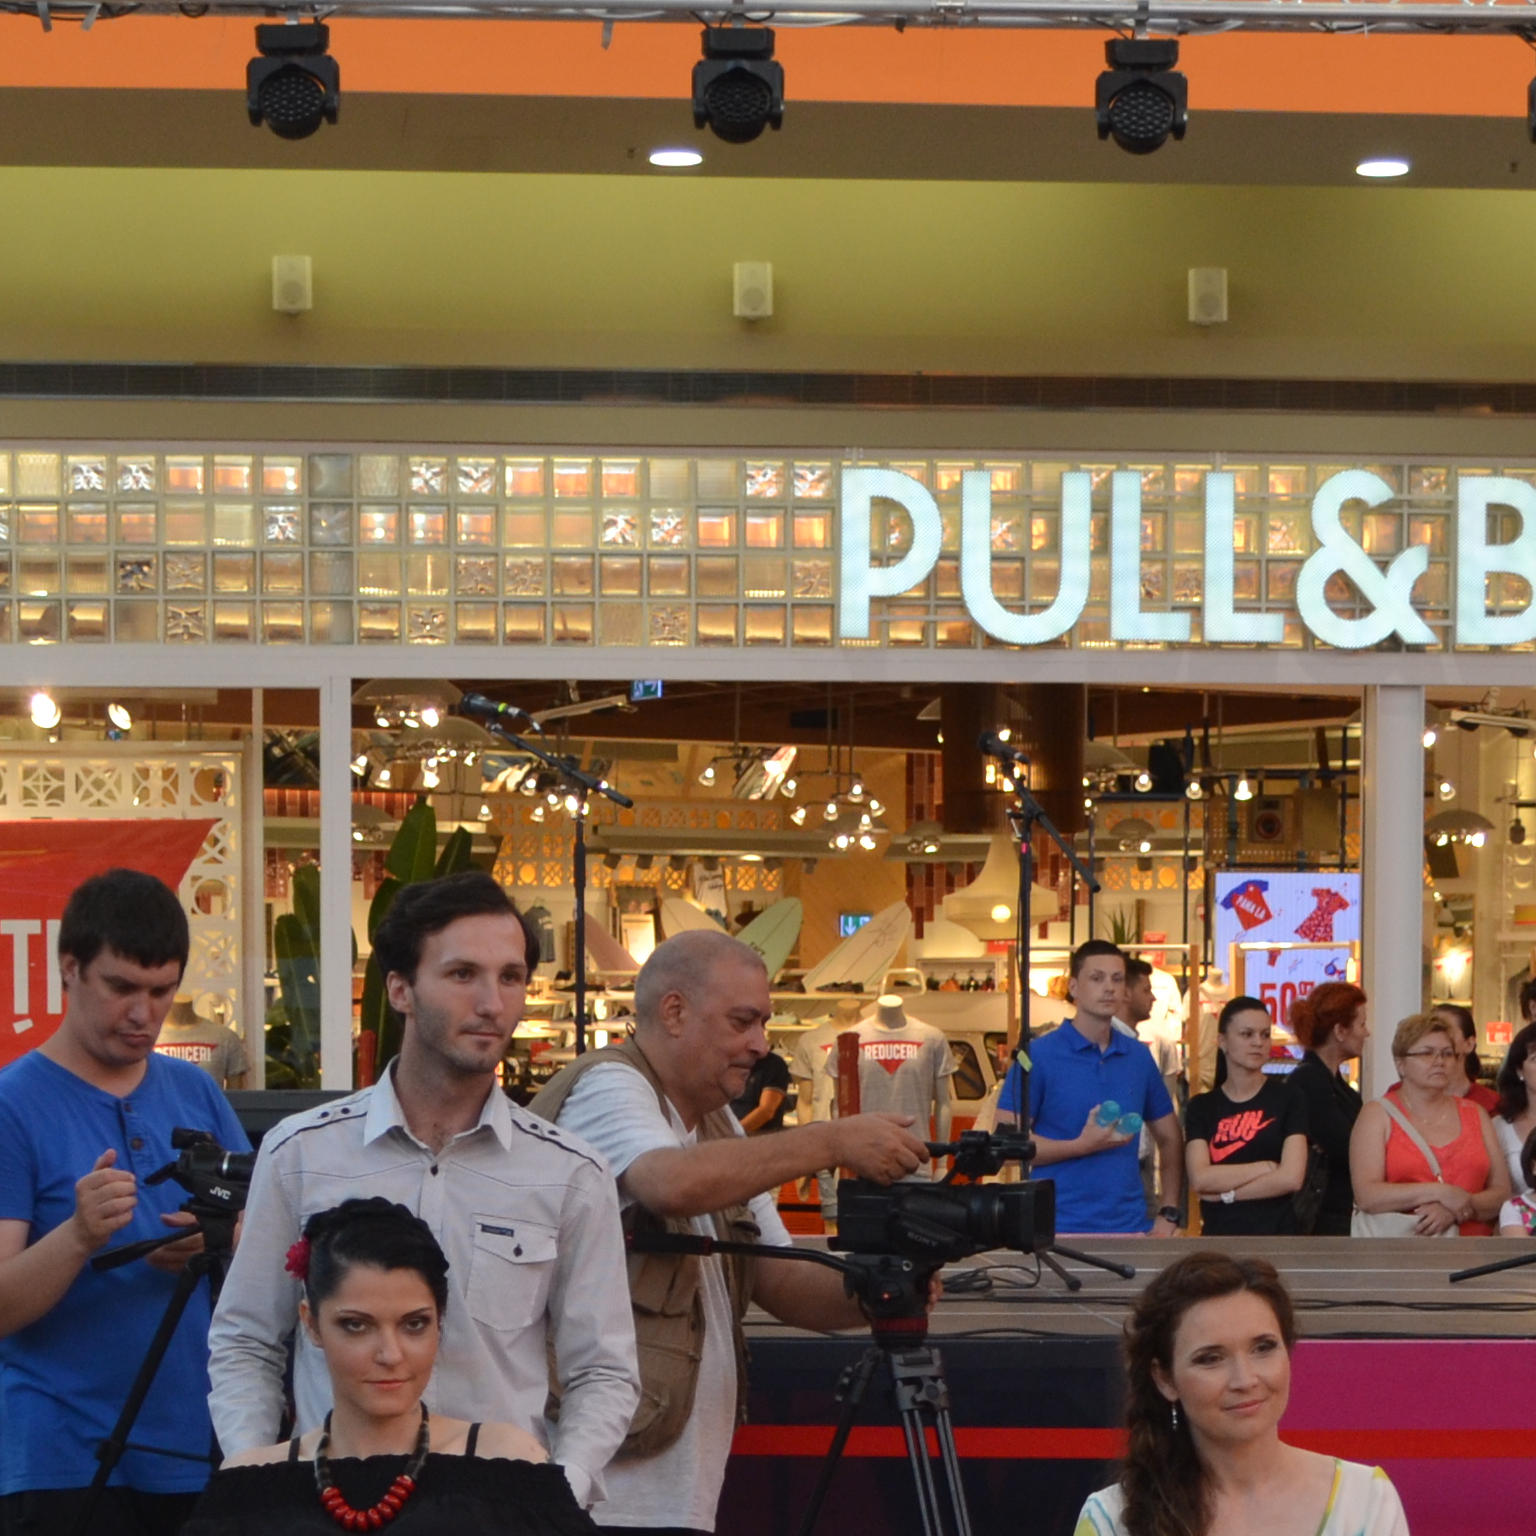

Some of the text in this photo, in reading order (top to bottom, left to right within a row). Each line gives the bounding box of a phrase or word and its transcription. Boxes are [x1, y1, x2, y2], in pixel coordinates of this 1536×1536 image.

[864, 1043, 918, 1060] REDUCERI
[209, 1185, 232, 1200] JVC
[906, 1230, 939, 1248] SONY
